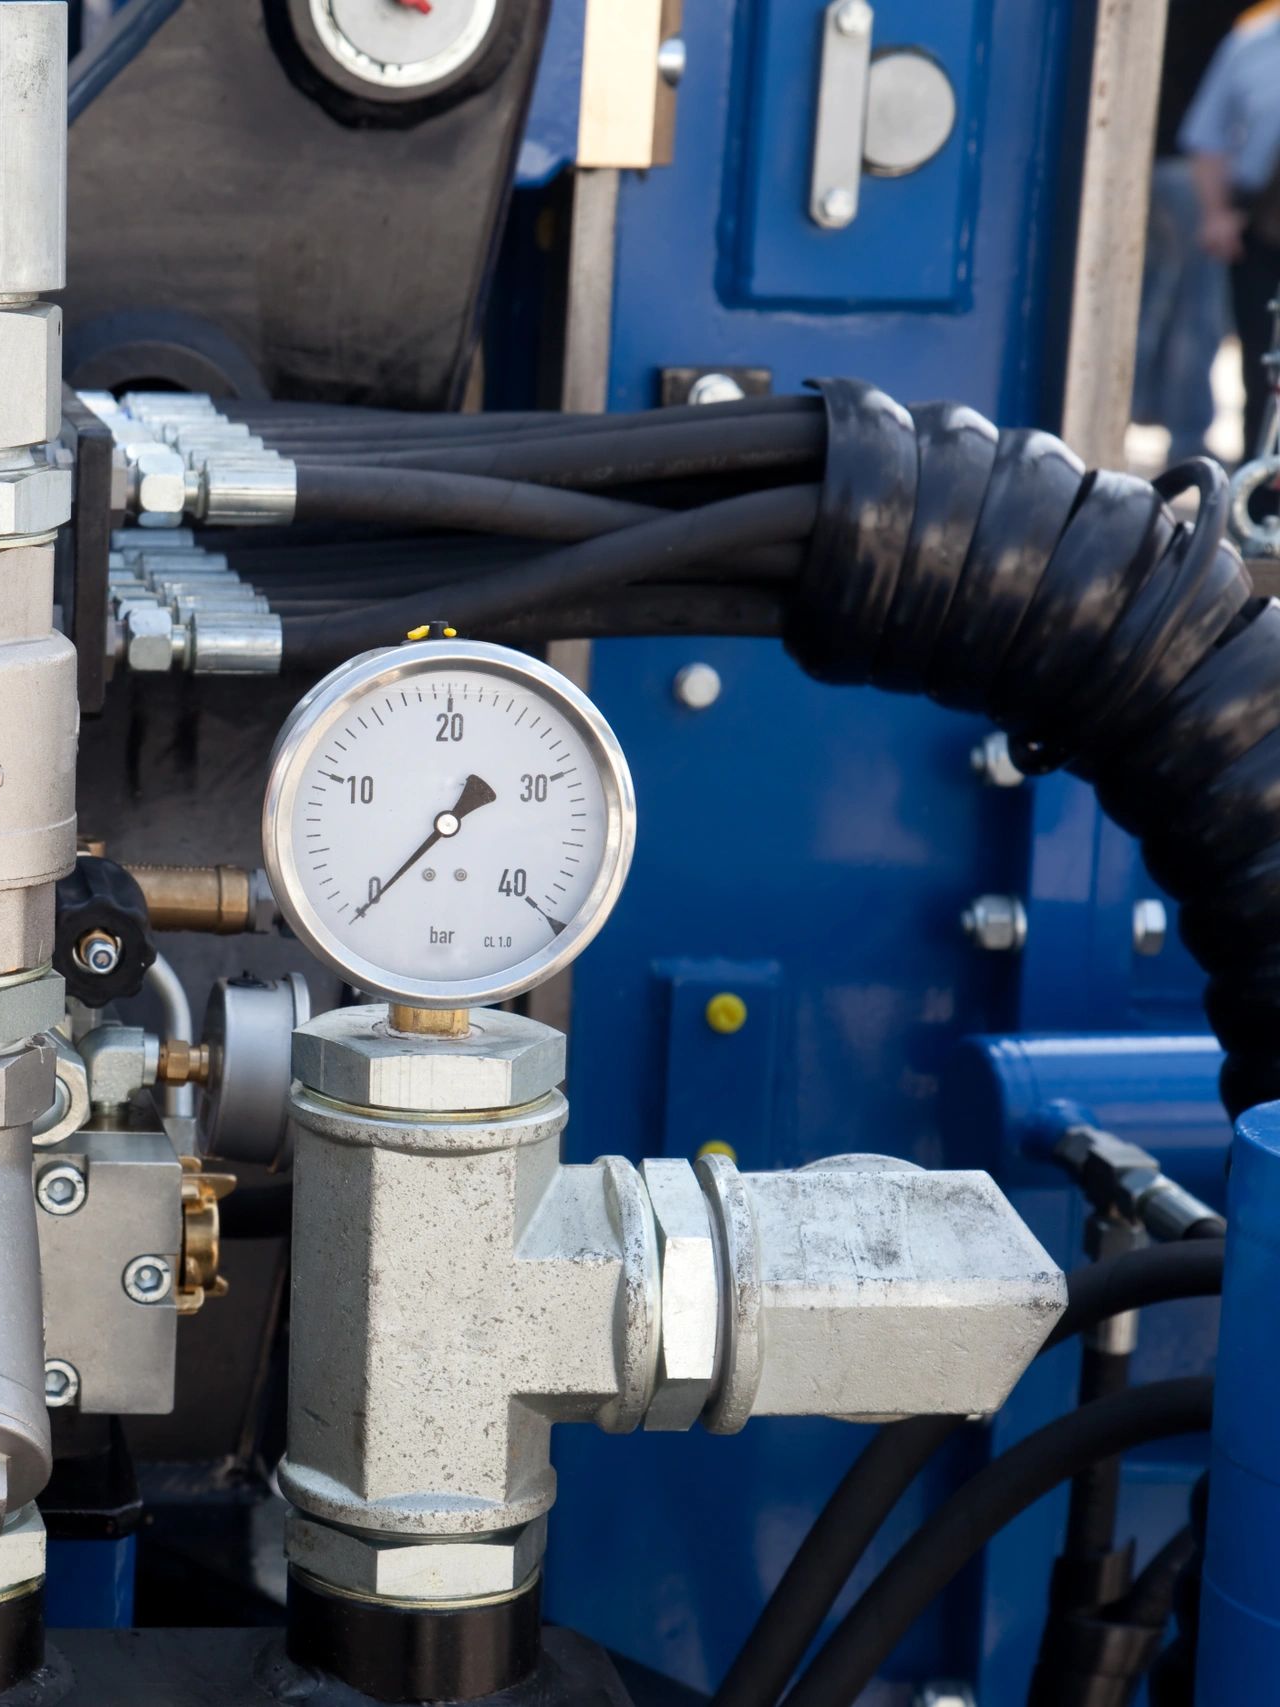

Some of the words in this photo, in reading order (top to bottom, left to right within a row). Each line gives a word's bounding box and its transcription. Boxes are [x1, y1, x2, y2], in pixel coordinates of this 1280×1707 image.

[436, 713, 464, 742] 20
[347, 775, 374, 804] 10
[520, 774, 548, 802] 30
[369, 876, 382, 904] 0
[498, 868, 527, 897] 40
[430, 926, 455, 944] bar
[484, 936, 496, 948] CL
[498, 936, 512, 948] 1.0
